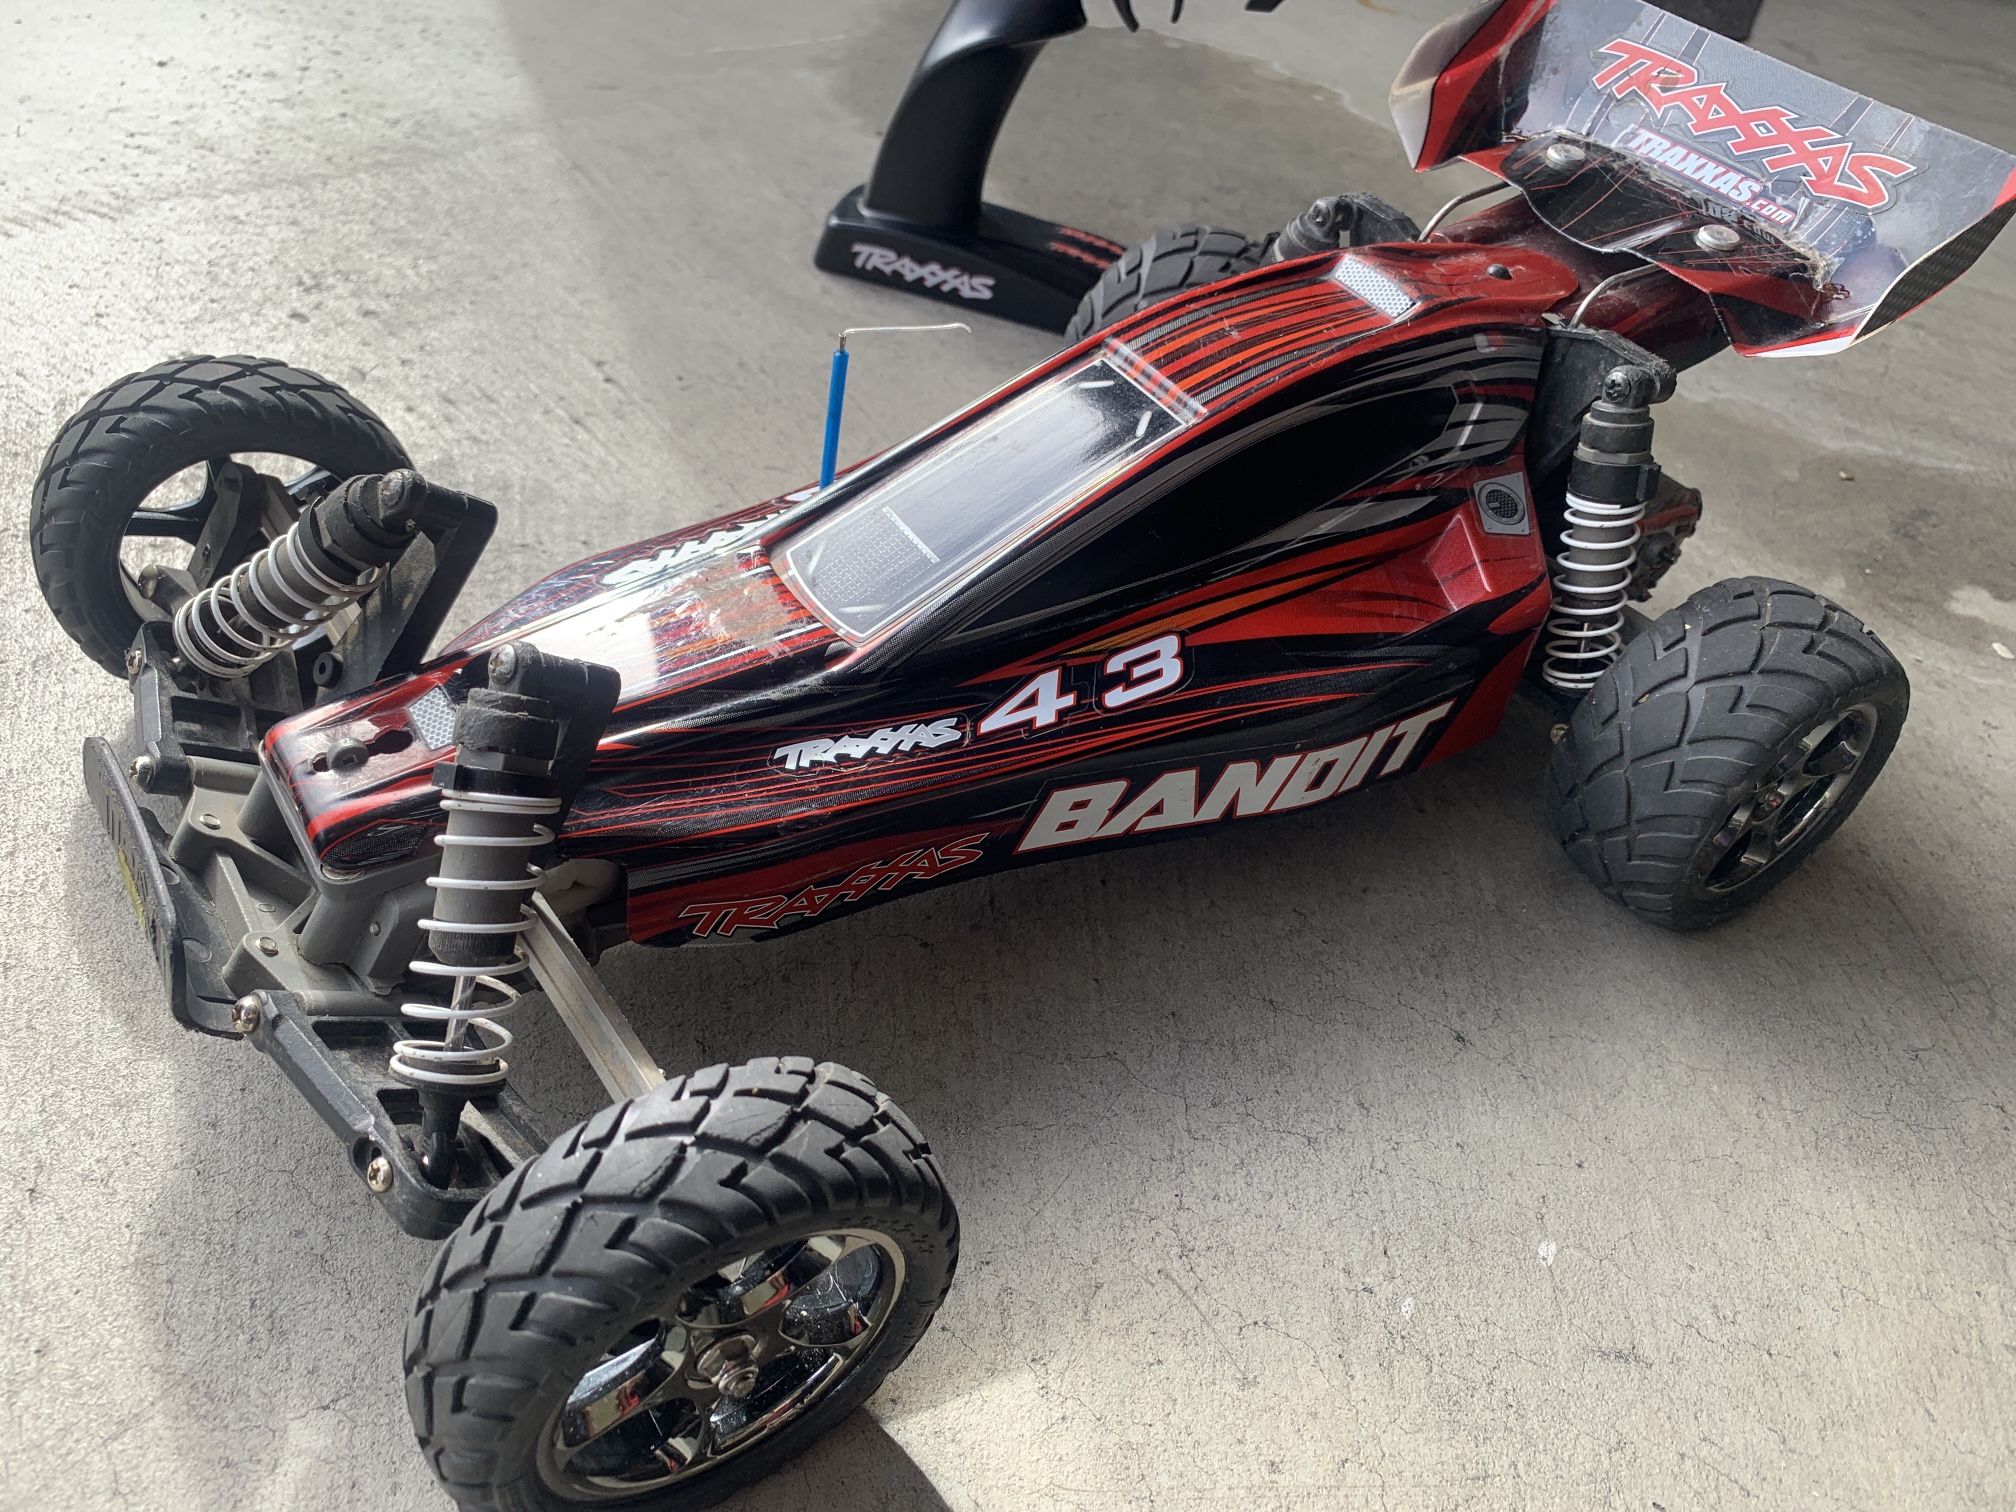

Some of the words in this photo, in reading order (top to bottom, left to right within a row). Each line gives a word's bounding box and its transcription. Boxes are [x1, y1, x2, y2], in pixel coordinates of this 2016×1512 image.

[1593, 37, 1916, 208] TRAXXAS
[851, 243, 995, 299] TRAXXAS
[773, 717, 963, 770] TRAXXAS
[1013, 698, 1457, 855] BANDIT
[679, 833, 989, 938] TRAXXAS
